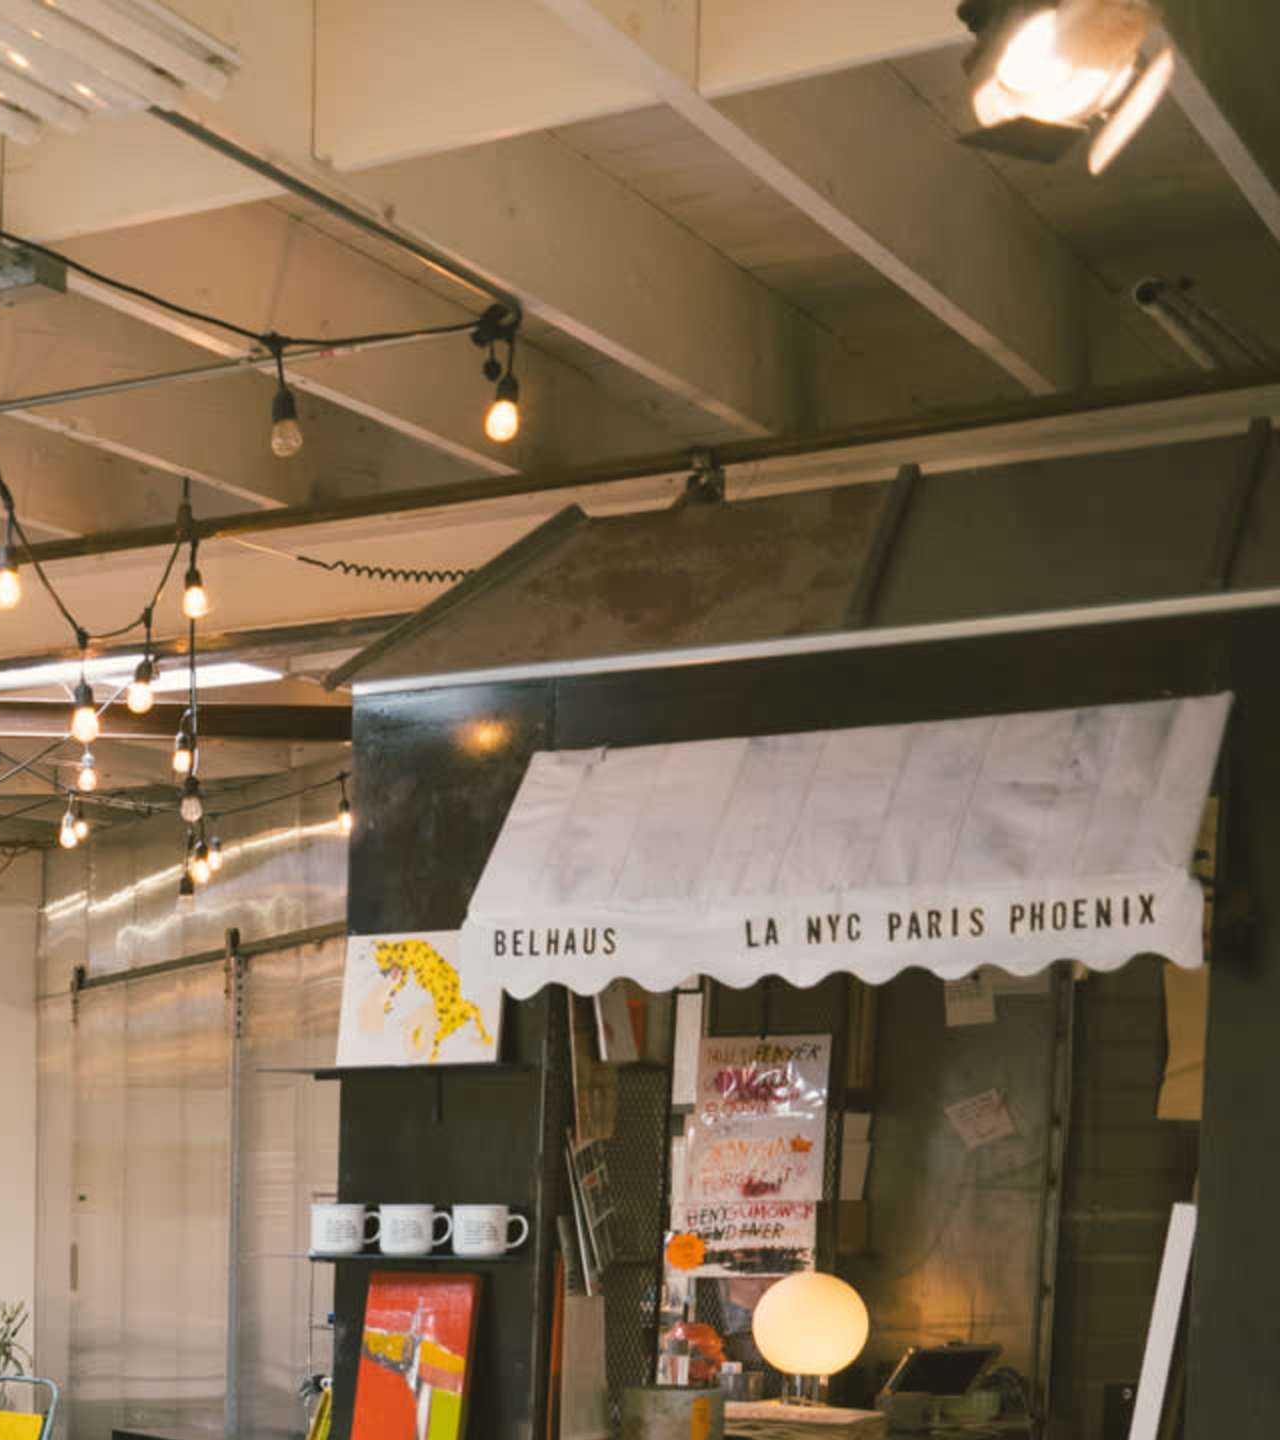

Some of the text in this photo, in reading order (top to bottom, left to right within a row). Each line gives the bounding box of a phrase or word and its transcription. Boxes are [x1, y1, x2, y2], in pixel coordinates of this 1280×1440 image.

[745, 893, 1156, 948] LA NYC PARIS PHOENIX
[494, 927, 617, 957] BELHAUS
